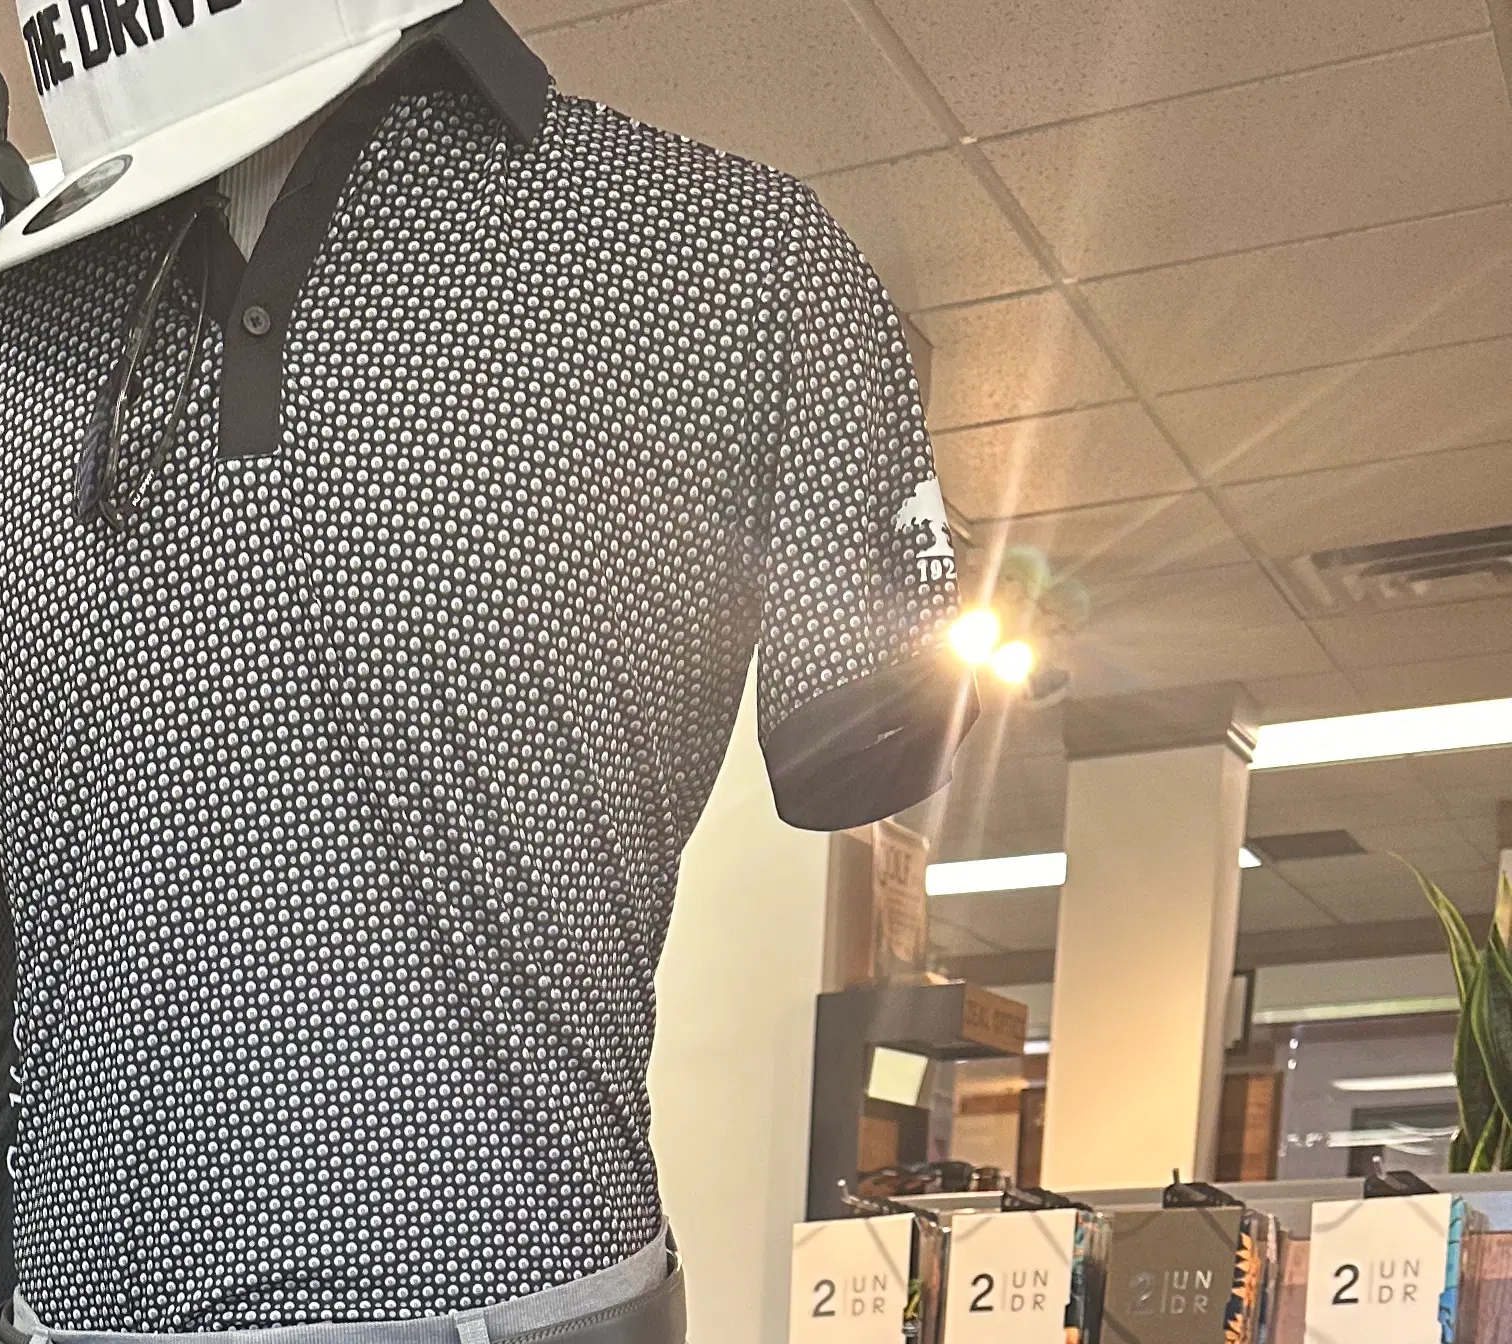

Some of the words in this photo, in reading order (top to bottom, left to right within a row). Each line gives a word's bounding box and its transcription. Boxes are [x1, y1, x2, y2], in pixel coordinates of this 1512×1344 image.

[22, 3, 75, 96] THE
[69, 0, 243, 71] DRI
[916, 556, 955, 583] 192
[812, 1279, 836, 1318] 2
[852, 1275, 887, 1293] UN
[969, 1273, 995, 1312] 2
[1012, 1270, 1049, 1289] UN
[1128, 1271, 1157, 1315] 2
[1173, 1270, 1212, 1289] UN
[1332, 1264, 1359, 1305] 2
[1380, 1260, 1420, 1279] UN
[1378, 1284, 1417, 1304] DR
[851, 1298, 885, 1316] DR
[1010, 1294, 1045, 1312] DR
[1169, 1295, 1208, 1314] DR
